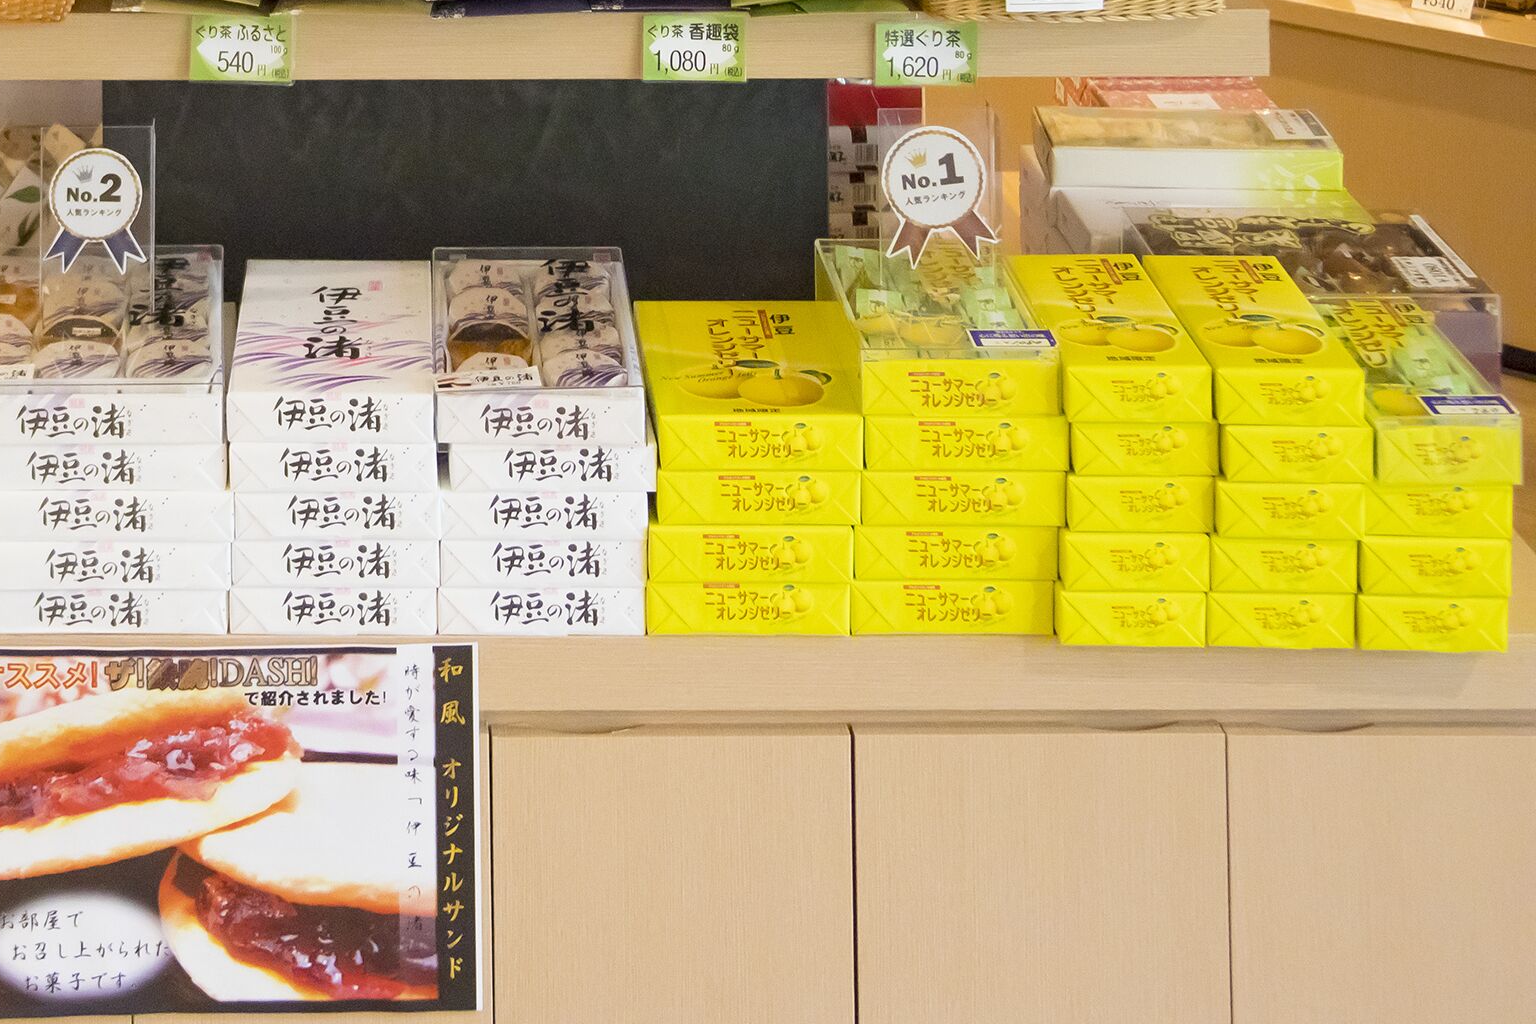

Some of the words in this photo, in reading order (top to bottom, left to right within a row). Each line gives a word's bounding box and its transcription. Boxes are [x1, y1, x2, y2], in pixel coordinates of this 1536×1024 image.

[195, 25, 232, 39] ぐり茶
[237, 24, 286, 42] ふるさと
[647, 24, 684, 39] ぐり茶
[689, 23, 739, 42] 香趣袋
[884, 29, 961, 48] 特選ぐり茶
[901, 152, 965, 190] No.1
[66, 173, 122, 203] No.2
[905, 190, 966, 206] 人気ランキング
[66, 208, 122, 217] 人気ランキング
[302, 285, 363, 360] 伊豆の渚
[910, 379, 975, 393] ニューサマー
[921, 394, 996, 408] オレンジゼリー
[17, 404, 125, 438] 伊豆の渚
[274, 396, 380, 432] 伊豆の渚
[480, 404, 589, 440] 伊豆の渚
[716, 429, 782, 443] ニューサマー
[920, 429, 986, 444] ニューサマー
[728, 444, 802, 458] オレンジゼリー
[932, 444, 1007, 459] オレンジゼリー
[27, 450, 134, 484] 伊豆の渚
[280, 447, 387, 482] 伊豆の渚
[504, 446, 612, 482] 伊豆の渚
[721, 483, 786, 498] ニューサマー
[916, 483, 982, 498] ニューサマー
[39, 497, 146, 532] 伊豆の渚
[288, 494, 395, 530] 伊豆の渚
[489, 494, 597, 530] 伊豆の渚
[732, 499, 805, 513] オレンジゼリー
[927, 498, 1002, 513] オレンジゼリー
[704, 541, 771, 556] ニューサマー
[907, 538, 974, 553] ニューサマー
[46, 548, 153, 583] 伊豆の渚
[283, 543, 389, 578] 伊豆の渚
[493, 541, 599, 577] 伊豆の渚
[715, 557, 791, 571] オレンジゼリー
[919, 554, 995, 569] オレンジゼリー
[283, 590, 390, 626] 伊豆の渚
[491, 590, 598, 626] 伊豆の渚
[705, 592, 772, 606] ニューサマー
[905, 592, 971, 606] ニューサマー
[35, 592, 141, 627] 伊豆の渚
[716, 606, 791, 621] オレンジゼリー
[917, 607, 992, 622] オレンジゼリー
[438, 657, 466, 726] 和風
[441, 758, 464, 980] オリジナルサンド
[0, 910, 84, 931] お部屋で
[12, 940, 170, 961] お召し上がられた
[25, 971, 136, 994] お菓子です。
